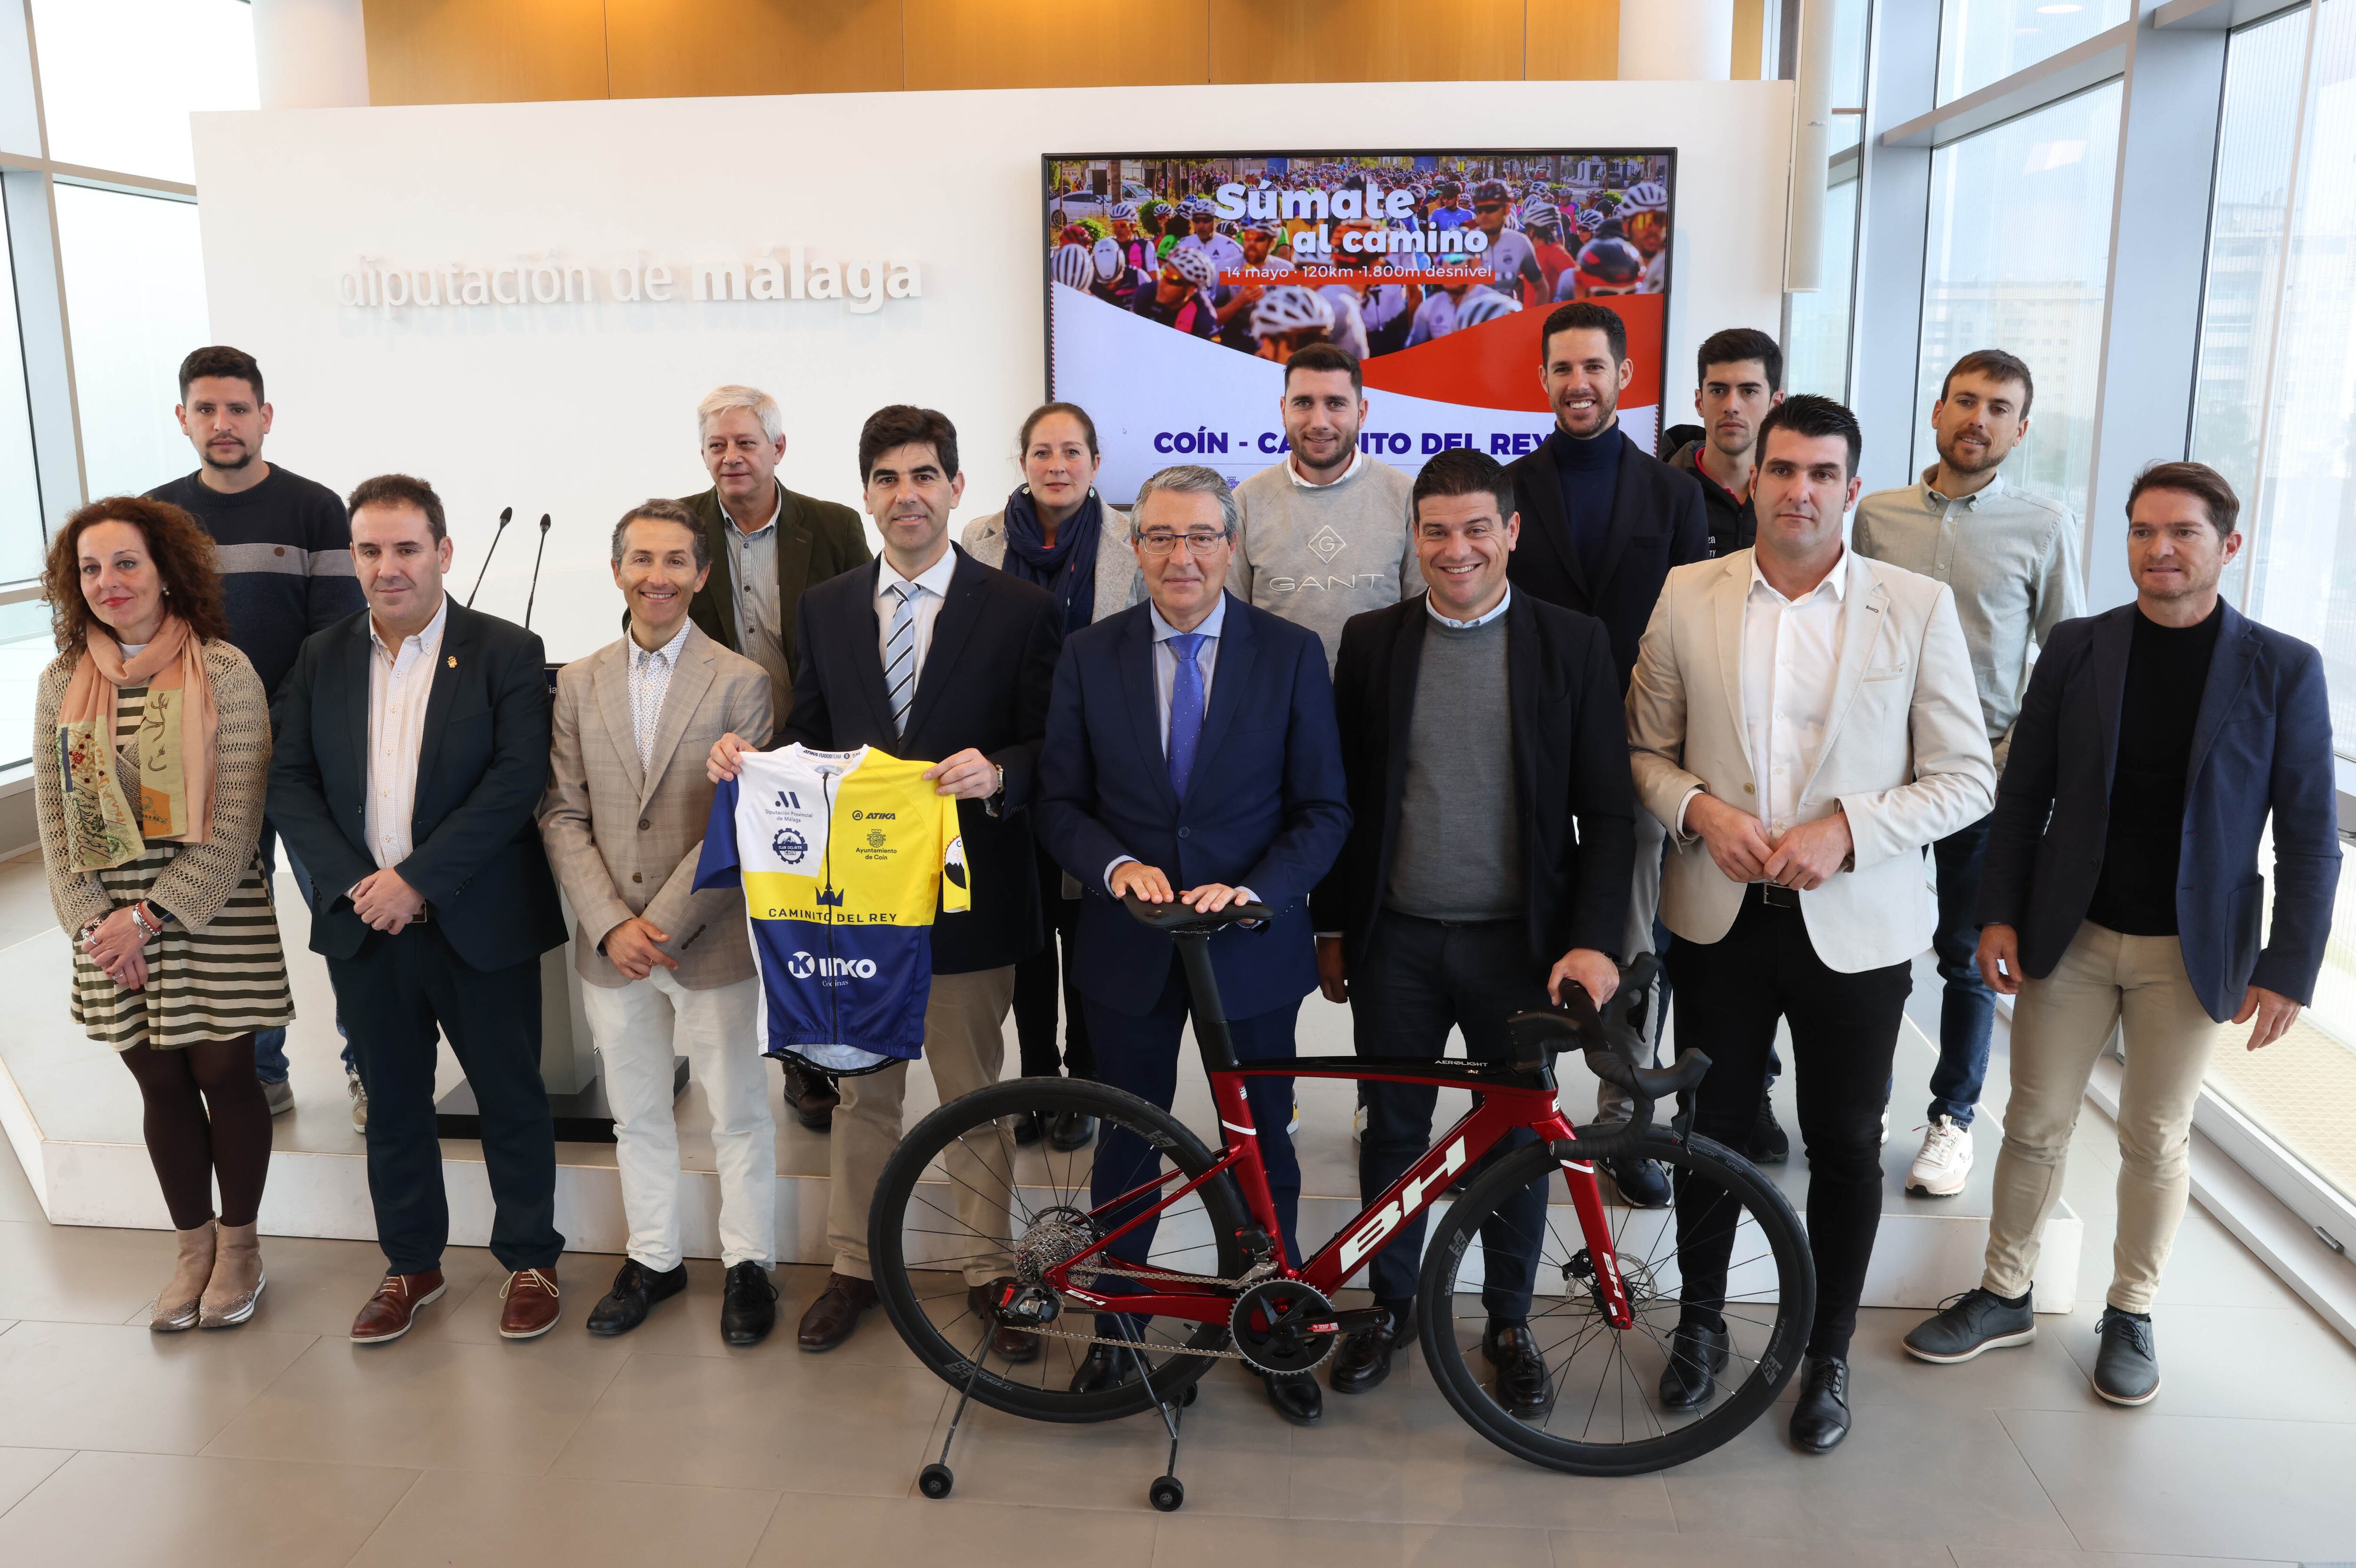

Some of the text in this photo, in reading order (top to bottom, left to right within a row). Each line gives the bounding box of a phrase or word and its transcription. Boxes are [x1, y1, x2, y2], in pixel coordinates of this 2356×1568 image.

[1214, 180, 1415, 220] Súmate
[1293, 222, 1488, 253] al camino
[339, 243, 922, 320] diputación de málaga
[1226, 267, 1240, 278] 14
[1245, 269, 1288, 281] mayo
[1302, 266, 1353, 278] 120km
[1425, 265, 1491, 278] desnivel
[1153, 425, 1228, 454] COÍN
[1258, 432, 1411, 454] CAITO
[1421, 433, 1481, 454] DEL
[1269, 574, 1385, 591] GANT
[769, 908, 897, 922] CAMINITO DEL REY
[1340, 1135, 1466, 1274] BH
[1602, 1251, 1623, 1299] BH
[1065, 1289, 1107, 1306] BH
